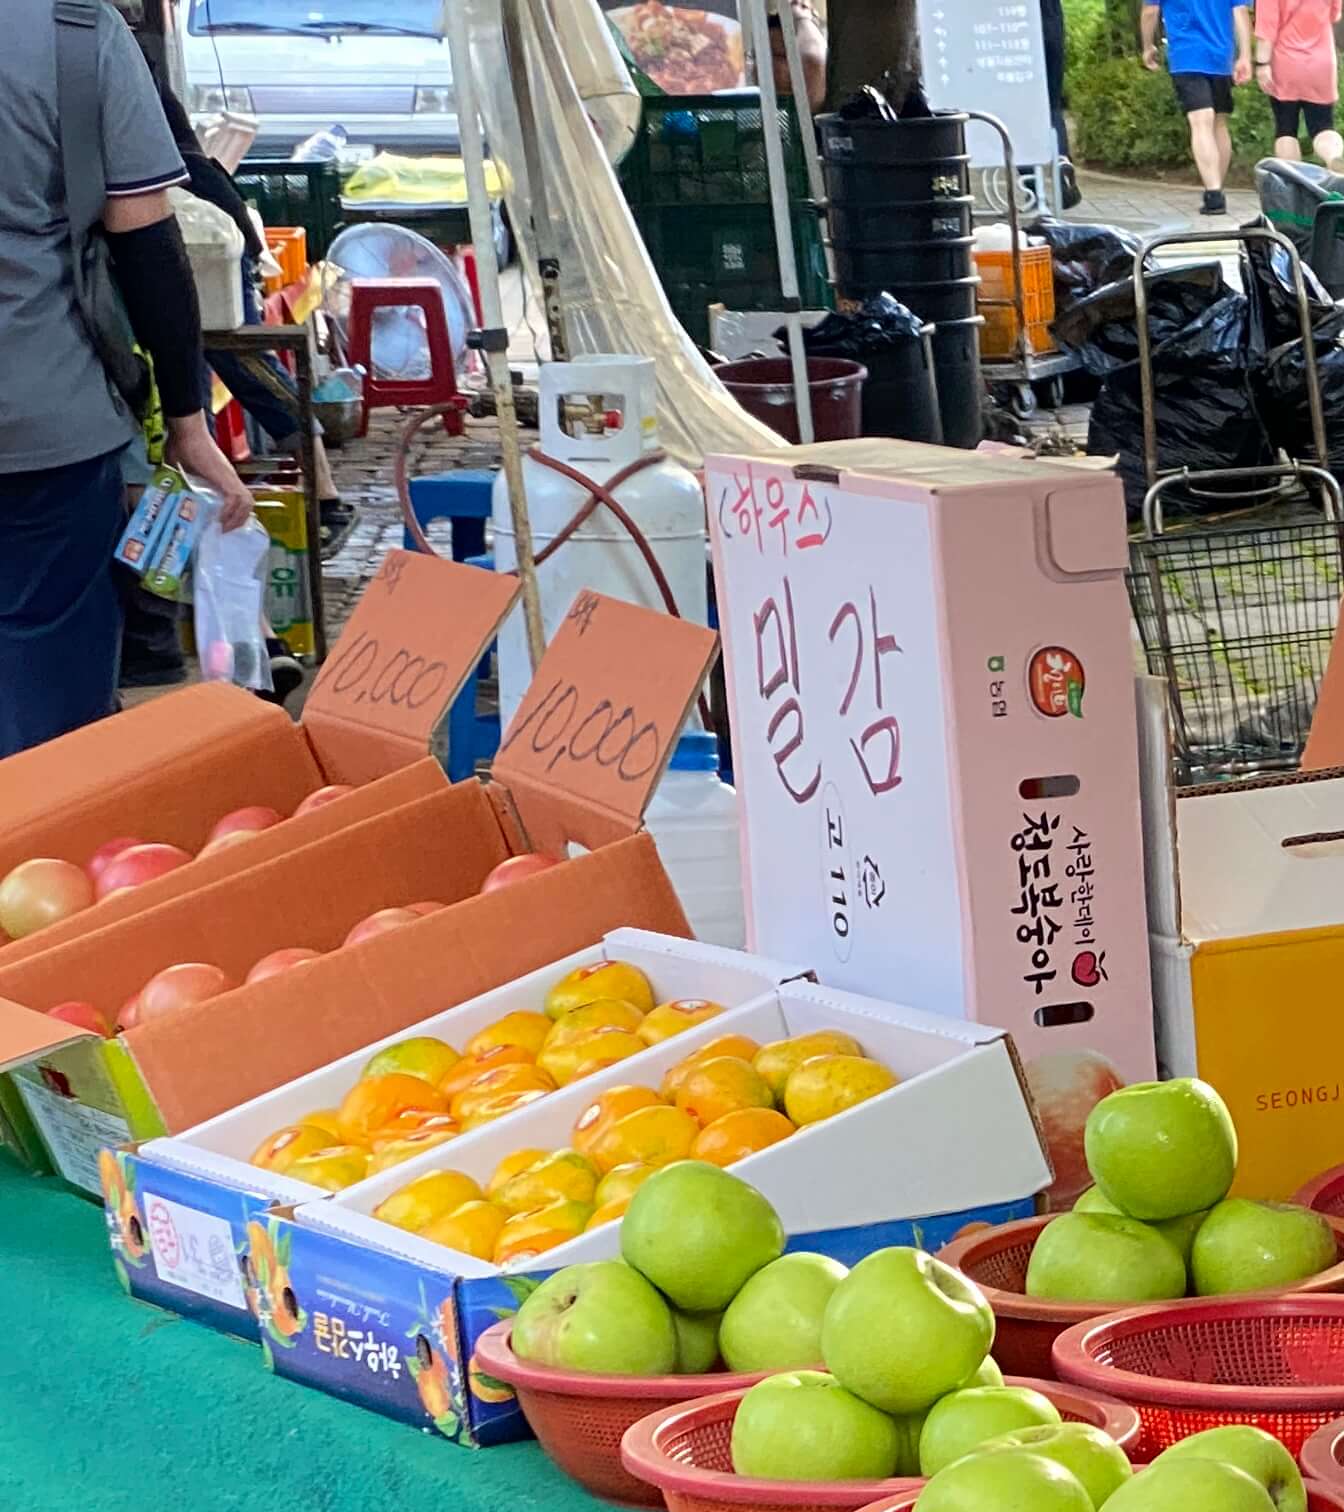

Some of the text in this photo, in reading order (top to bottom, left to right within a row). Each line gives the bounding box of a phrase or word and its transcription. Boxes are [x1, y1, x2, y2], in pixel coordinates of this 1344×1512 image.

[312, 631, 449, 710] 10,000
[753, 575, 903, 804] 밀감
[502, 680, 660, 782] 10,000
[1065, 825, 1097, 946] 사랑한데이
